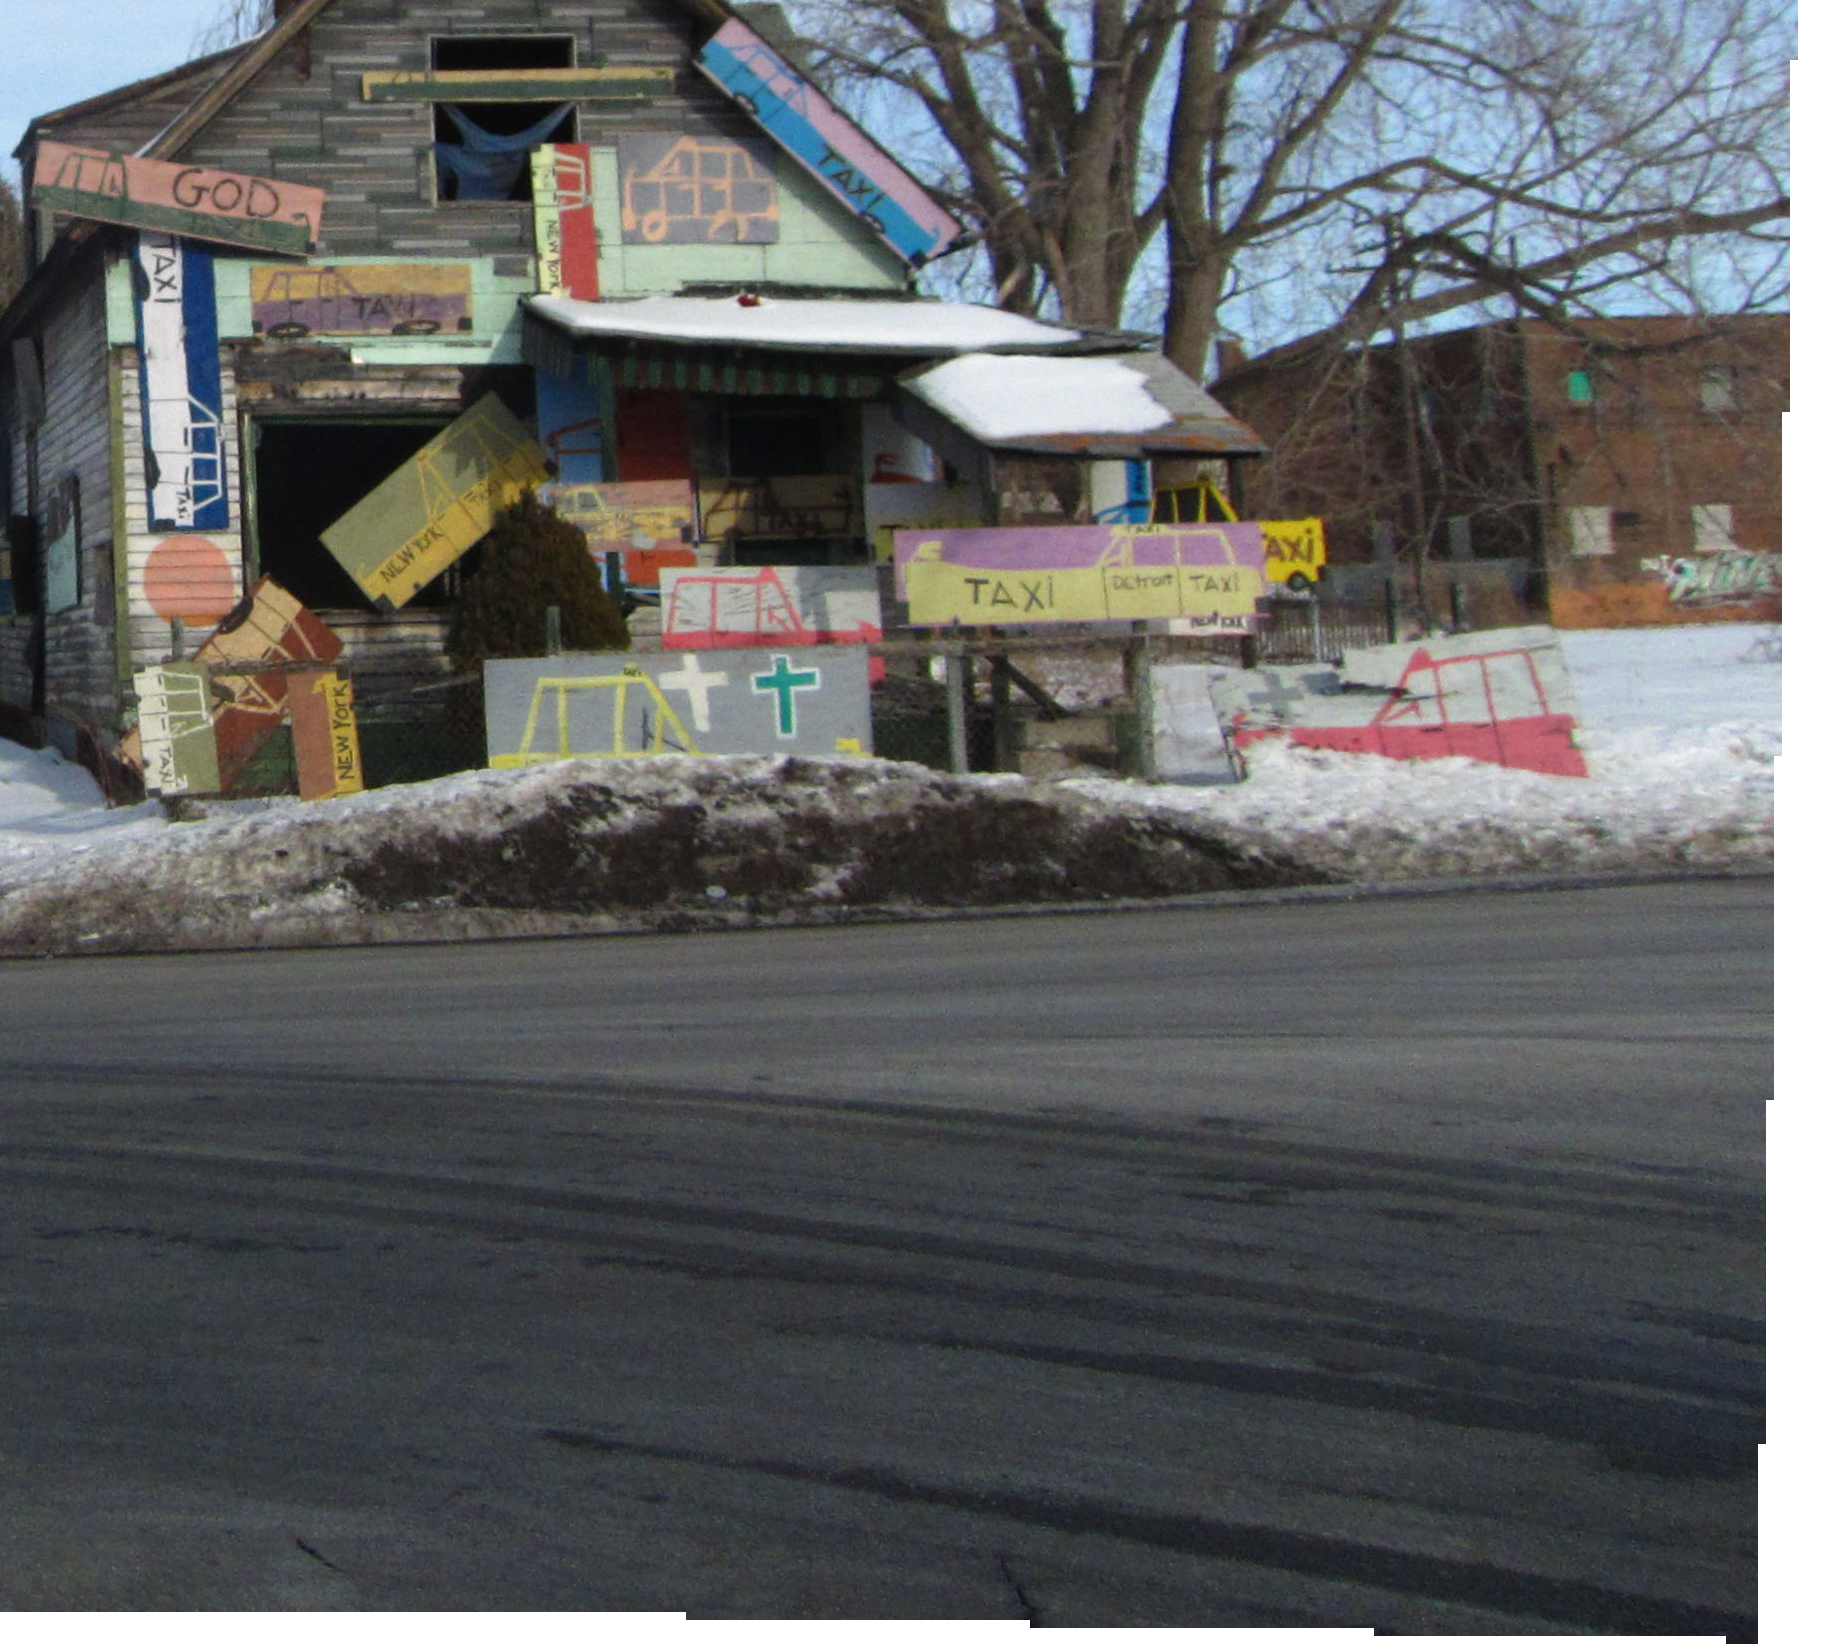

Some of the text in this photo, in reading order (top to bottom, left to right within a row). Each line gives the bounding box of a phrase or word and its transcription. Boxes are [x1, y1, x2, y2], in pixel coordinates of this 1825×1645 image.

[172, 167, 280, 218] GOD
[818, 142, 887, 213] TAXI
[1261, 528, 1316, 564] AXi
[334, 736, 355, 781] NEW
